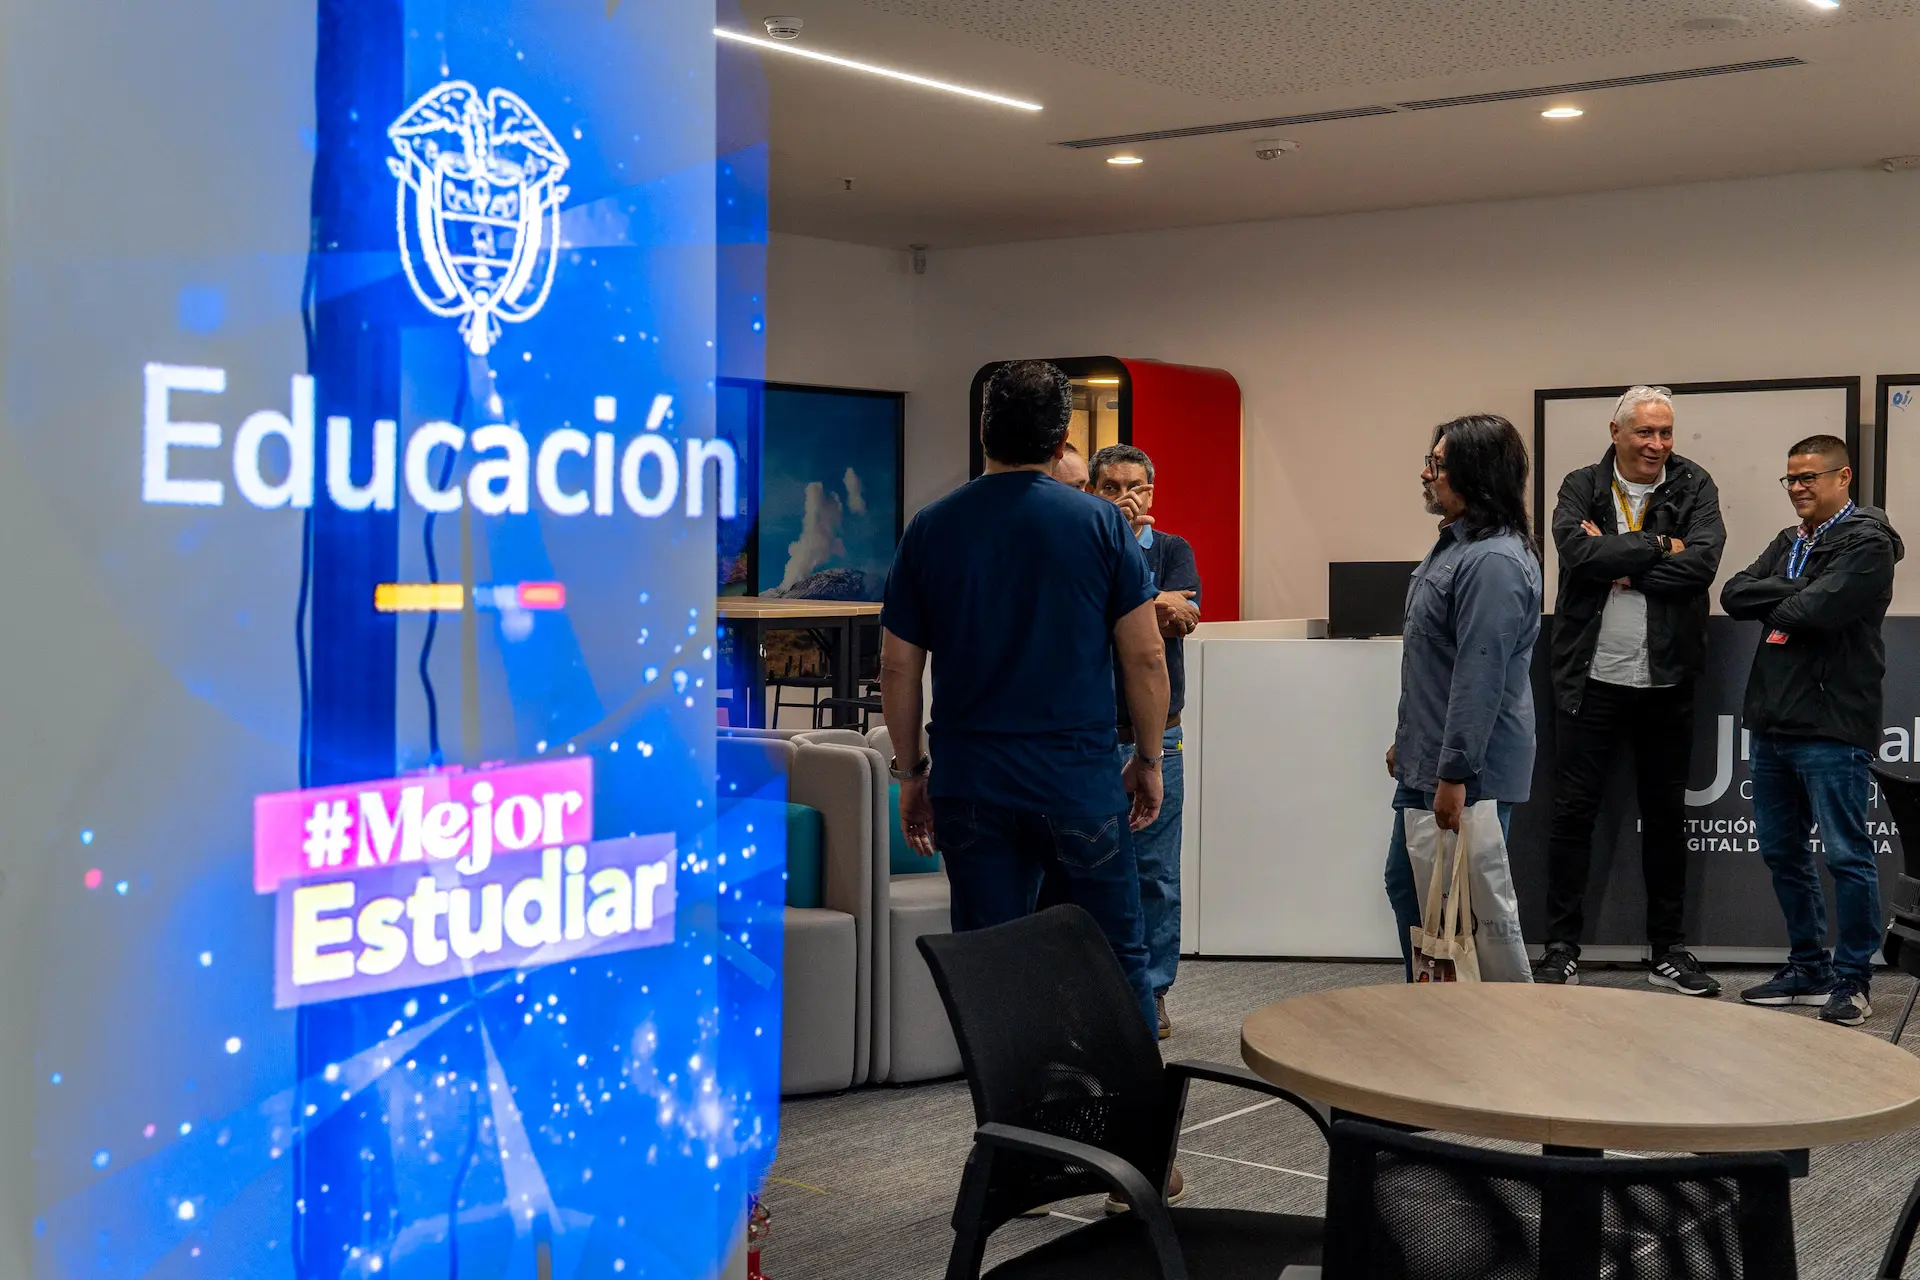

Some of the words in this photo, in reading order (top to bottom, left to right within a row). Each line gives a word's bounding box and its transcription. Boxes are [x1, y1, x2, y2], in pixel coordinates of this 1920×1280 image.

[142, 362, 738, 519] Educación
[303, 782, 583, 875] #Mejor
[1686, 838, 1743, 852] GITAL
[292, 845, 668, 985] Estudiar
